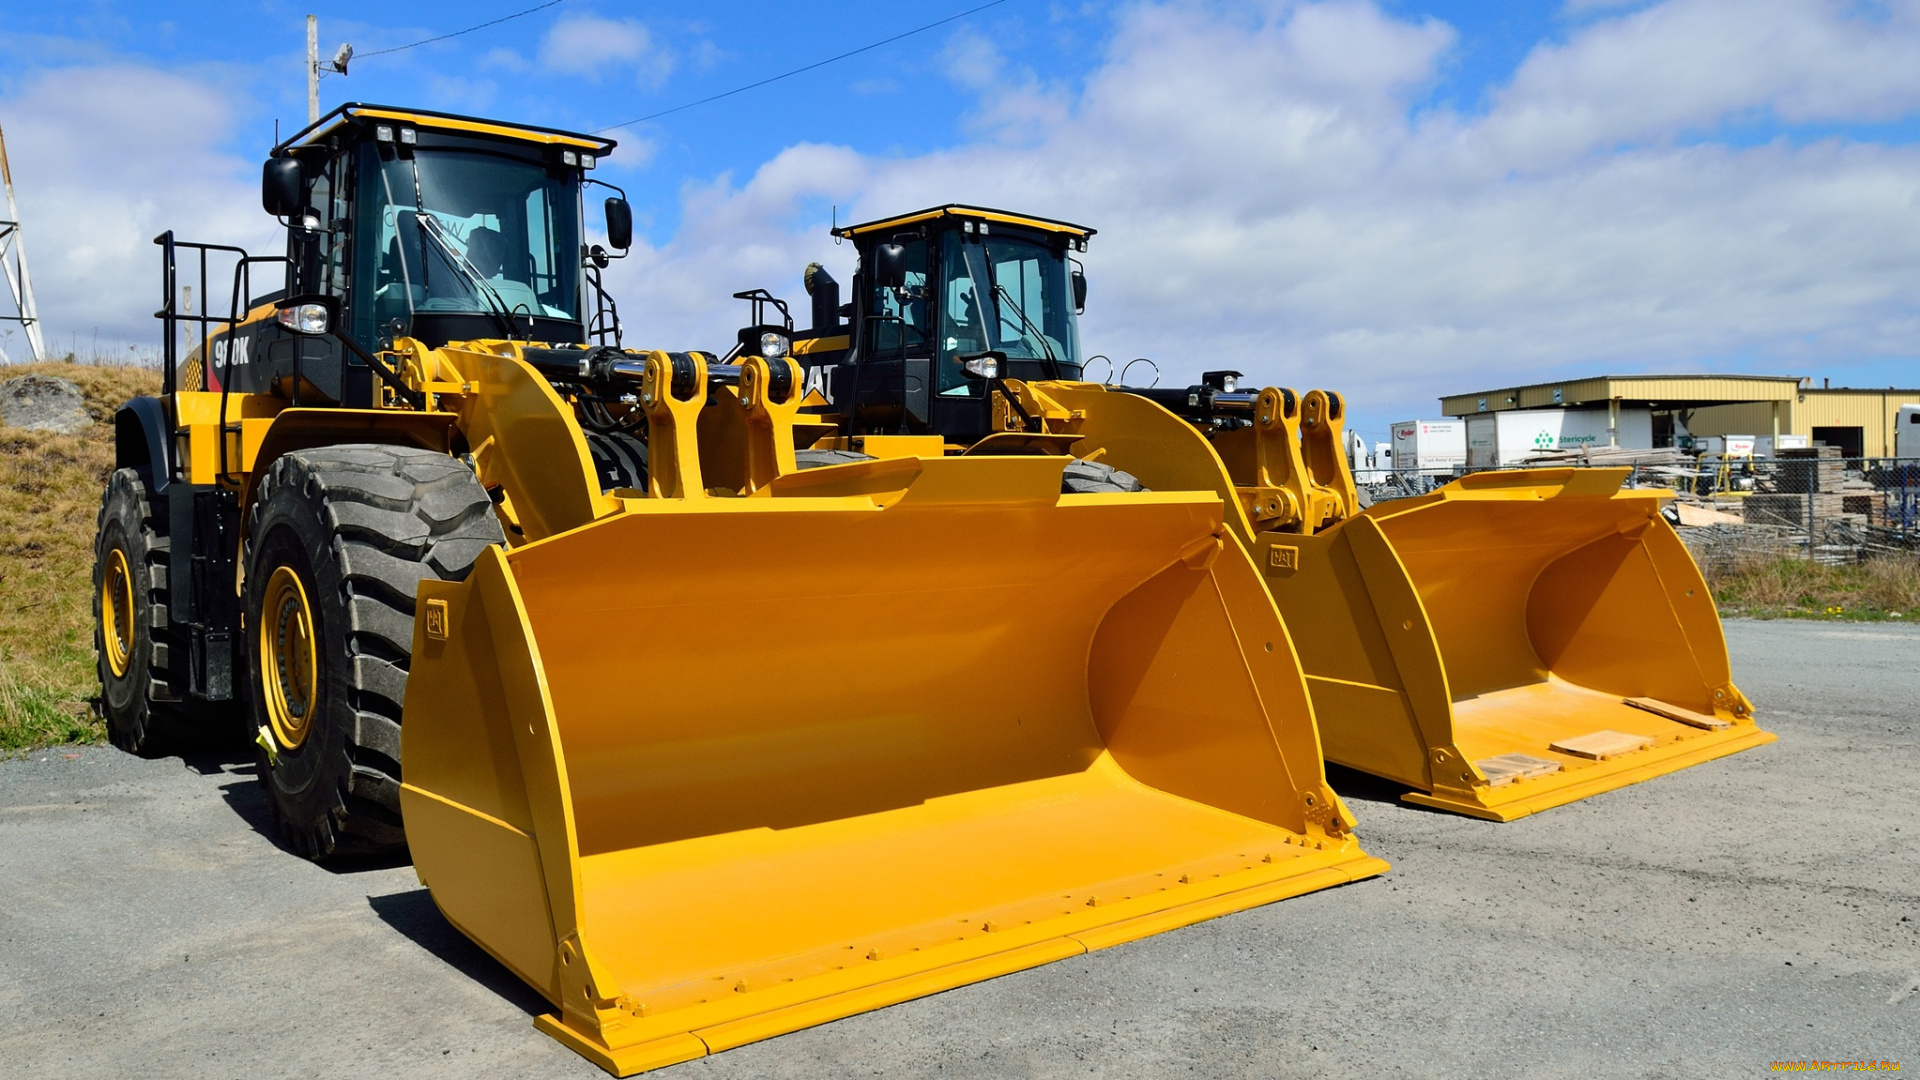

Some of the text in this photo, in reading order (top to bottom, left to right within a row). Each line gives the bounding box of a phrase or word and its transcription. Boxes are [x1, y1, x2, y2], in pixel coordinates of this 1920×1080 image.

[800, 364, 838, 405] AT
[1401, 429, 1415, 438] Ryder
[1559, 435, 1596, 444] Stericycle
